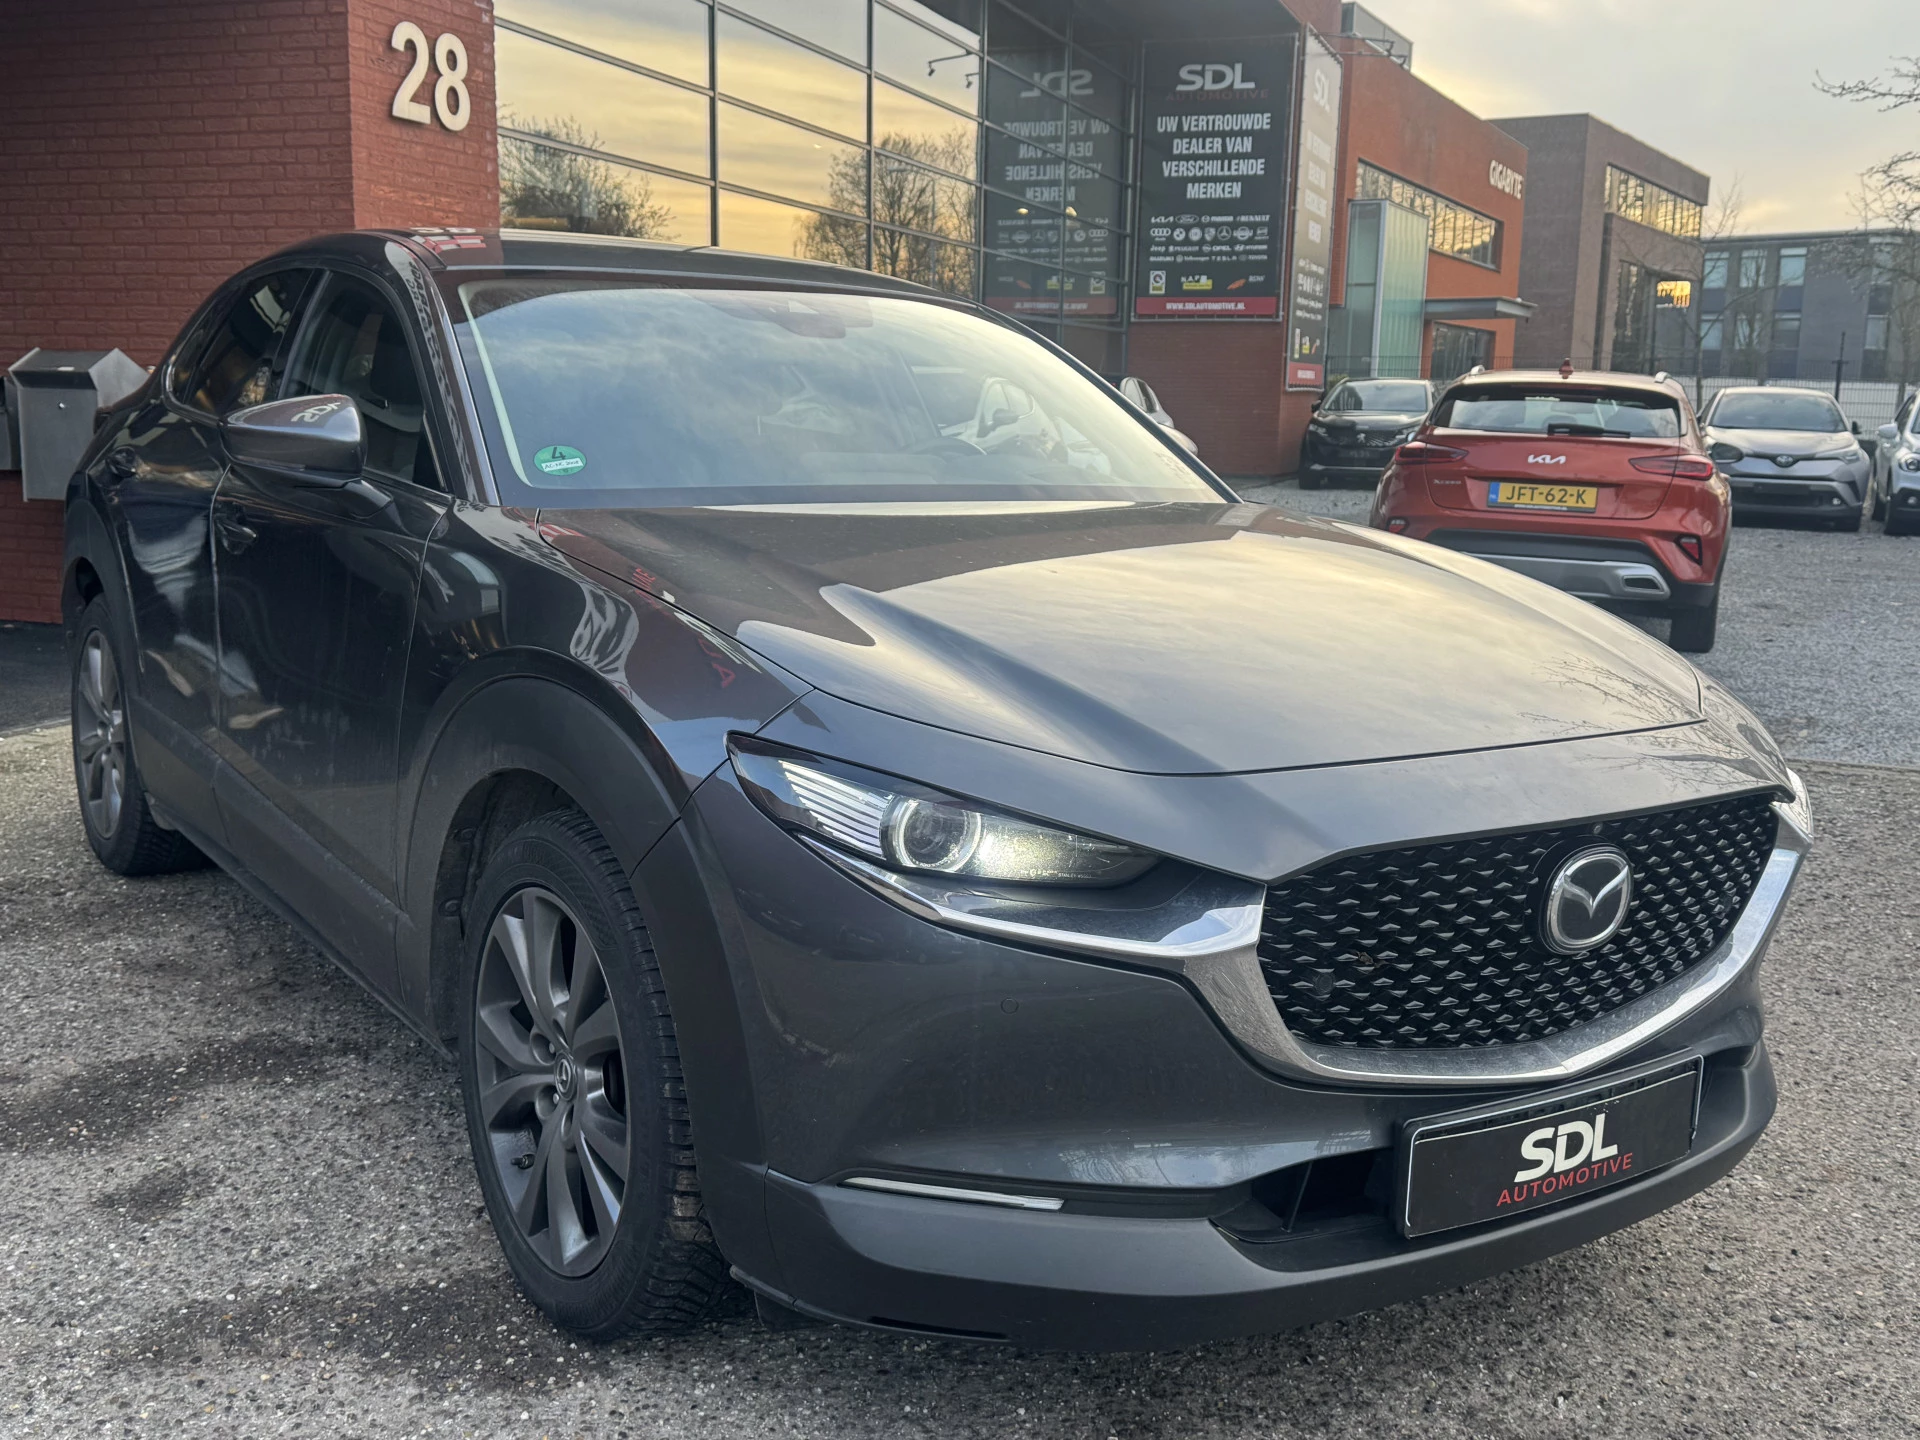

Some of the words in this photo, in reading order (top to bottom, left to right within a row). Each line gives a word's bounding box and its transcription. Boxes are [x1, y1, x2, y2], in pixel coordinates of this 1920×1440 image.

[391, 21, 471, 131] 28
[1176, 62, 1256, 91] SDL
[1166, 88, 1269, 101] AUTOMOTIVE
[1157, 116, 1178, 132] UW
[1182, 113, 1271, 132] VERTROUWDE
[1173, 137, 1222, 154] DEALER
[1226, 136, 1252, 153] VAN
[1162, 158, 1265, 177] VERSCHILLENDE
[1489, 160, 1523, 200] GIGABYTE
[1187, 181, 1241, 199] MERKEN
[552, 446, 566, 460] 4
[1528, 455, 1566, 464] KIA
[1506, 485, 1586, 504] JFT-62-K
[1514, 1113, 1618, 1183] SDL
[1496, 1153, 1633, 1206] AUTOMOTIVE
